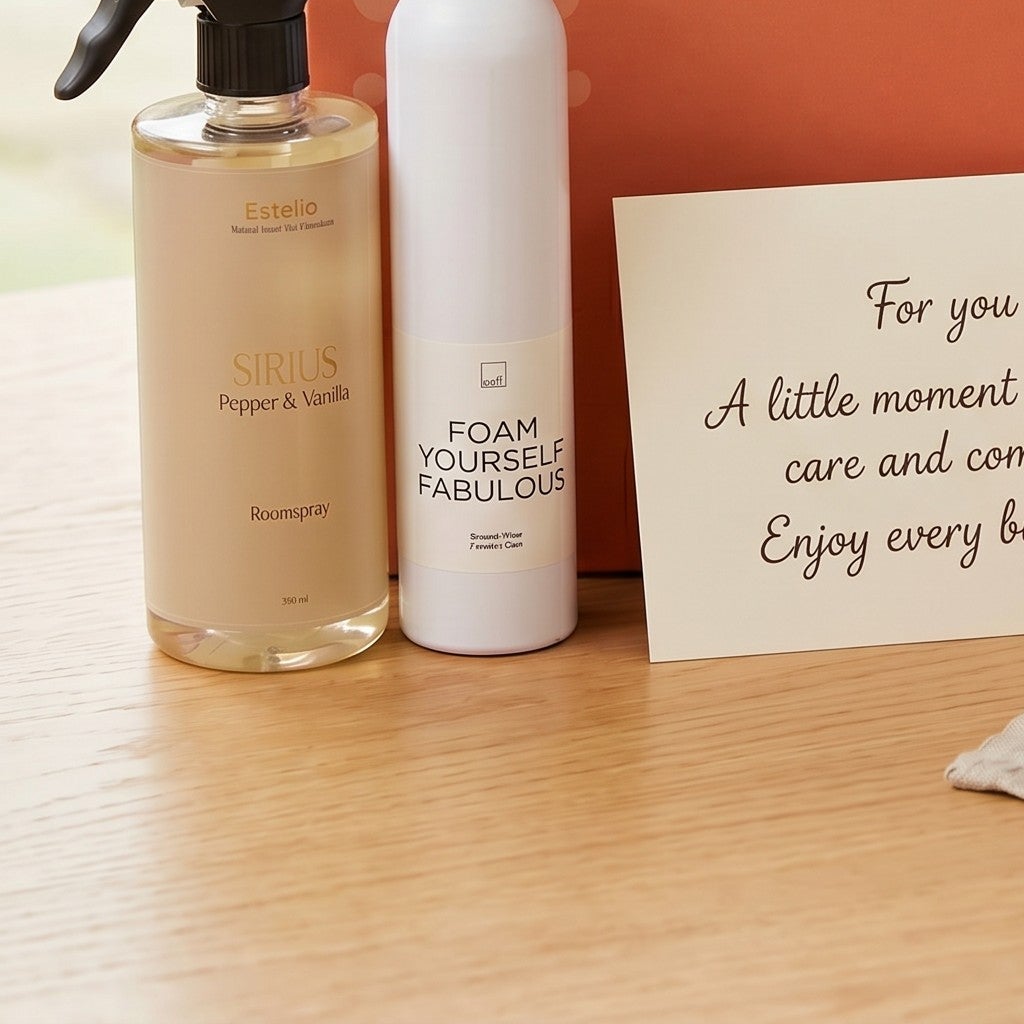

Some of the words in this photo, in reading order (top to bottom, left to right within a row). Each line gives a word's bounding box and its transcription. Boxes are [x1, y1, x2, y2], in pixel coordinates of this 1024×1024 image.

[245, 199, 318, 220] Estelio
[866, 276, 933, 330] For
[947, 294, 1018, 343] you
[233, 345, 338, 387] SIRIUS
[219, 393, 279, 416] Pepper
[282, 392, 298, 410] &
[302, 384, 350, 407] Vanilla
[704, 378, 749, 429] A
[767, 373, 859, 422] little
[872, 368, 1018, 415] moment
[449, 417, 537, 444] FOAM
[419, 438, 564, 473] YOURSELF
[785, 451, 865, 484] care
[878, 429, 952, 478] and
[419, 467, 565, 502] FABULOUS
[251, 502, 330, 523] Roomspray
[760, 514, 869, 580] Enjoy
[886, 521, 982, 569] every
